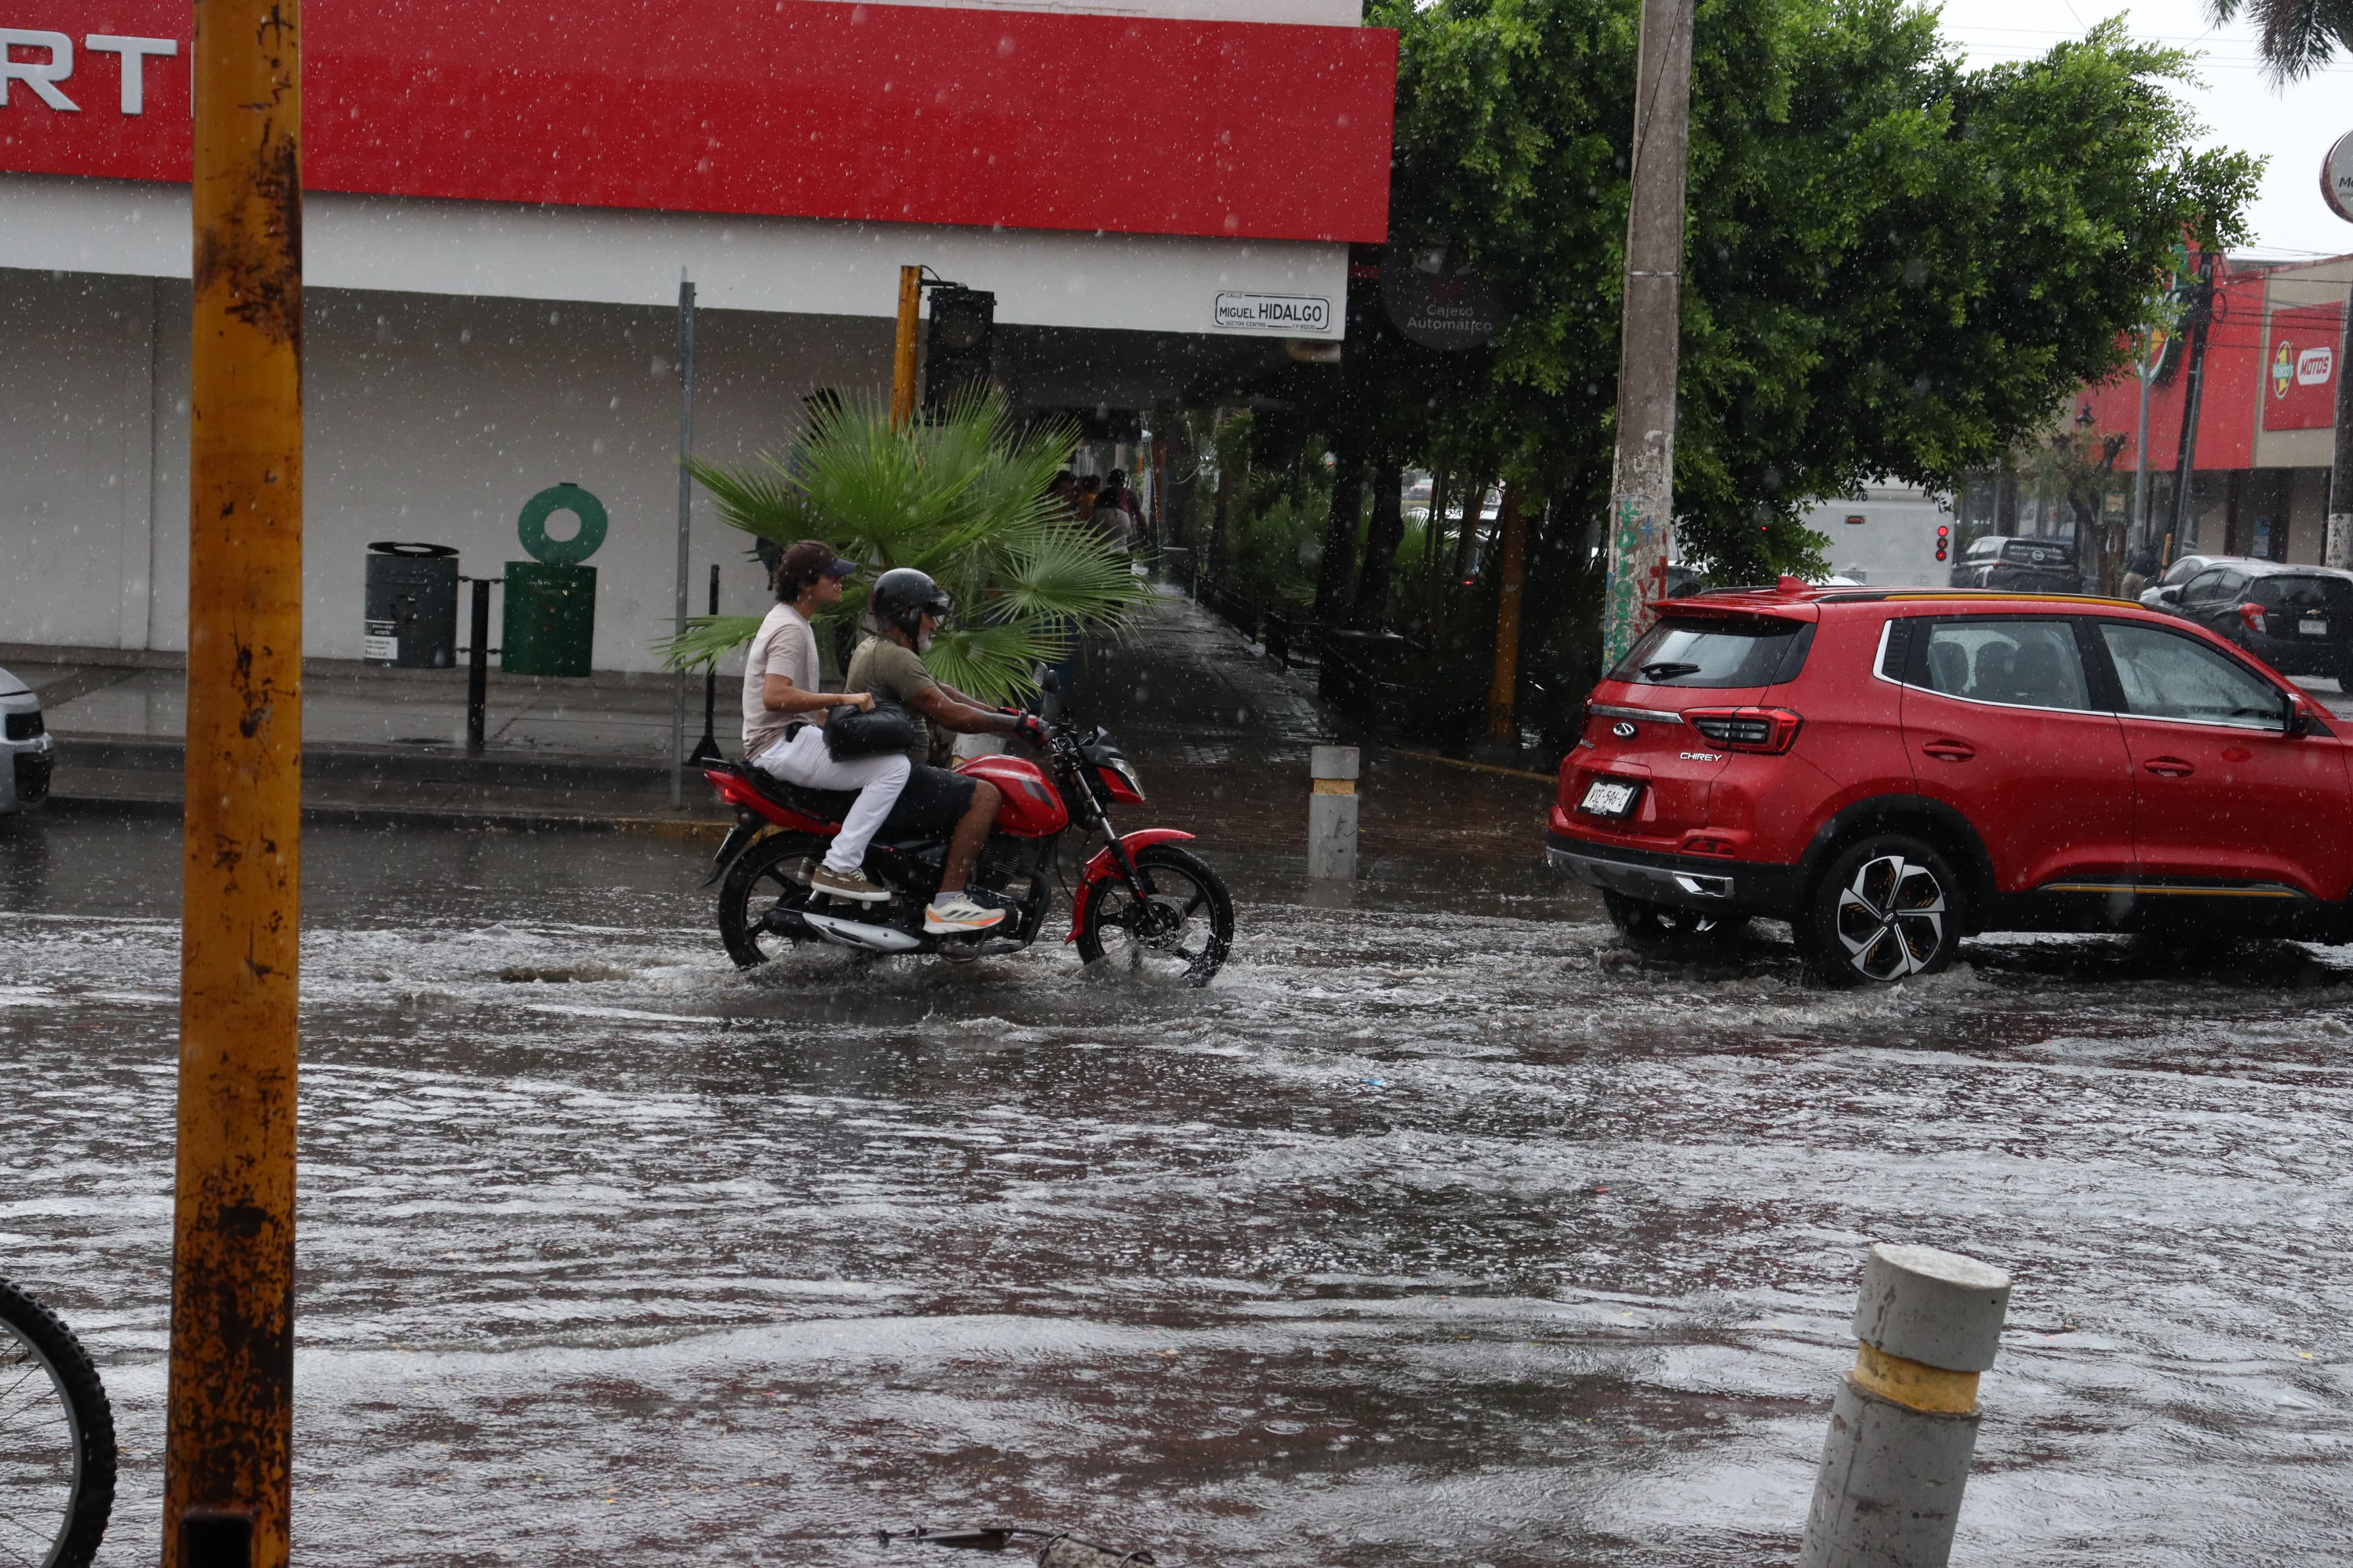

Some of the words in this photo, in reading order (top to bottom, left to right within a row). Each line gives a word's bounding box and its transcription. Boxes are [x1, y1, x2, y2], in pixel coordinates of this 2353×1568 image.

[0, 27, 194, 118] RT
[1219, 306, 1256, 319] MIGUEL
[1259, 303, 1322, 322] HIDALGO
[1427, 304, 1473, 318] Cajero
[2300, 356, 2329, 375] MOTOS
[1680, 751, 1723, 762] CHIREY
